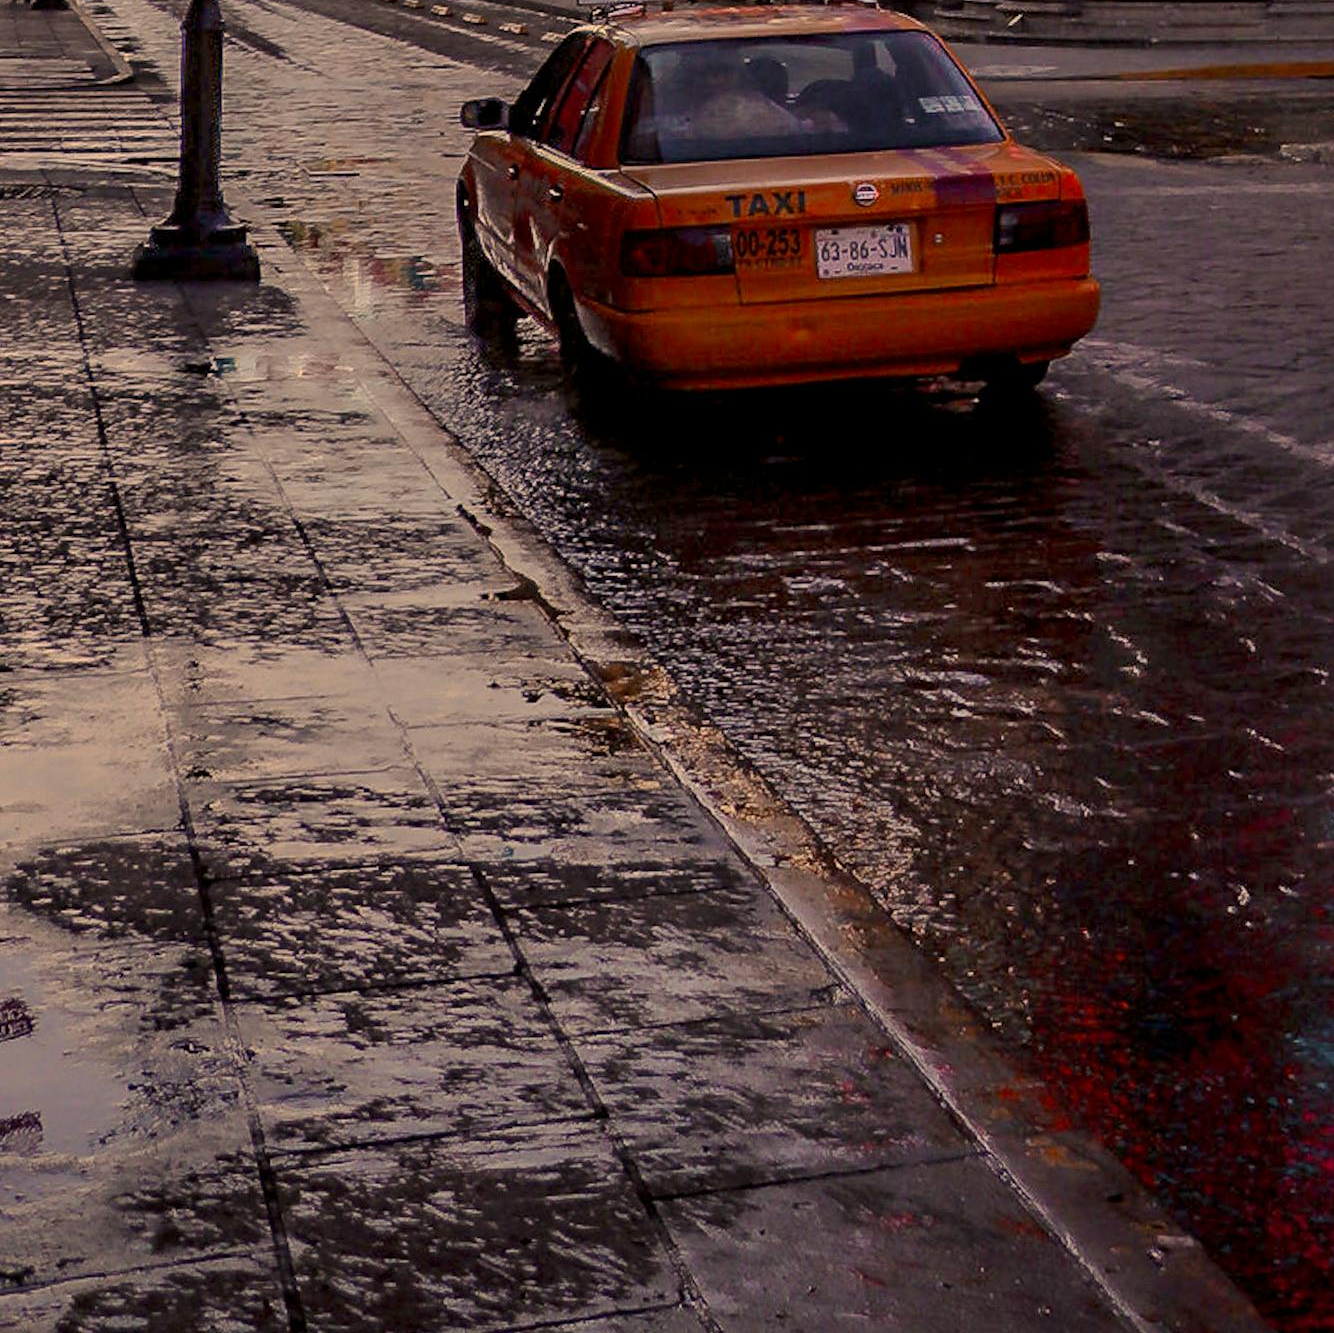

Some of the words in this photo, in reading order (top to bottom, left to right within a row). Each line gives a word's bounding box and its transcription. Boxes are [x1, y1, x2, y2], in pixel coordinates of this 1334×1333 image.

[725, 189, 806, 218] TAXI
[736, 229, 802, 258] 00-253
[821, 229, 908, 262] 63-86-SJN
